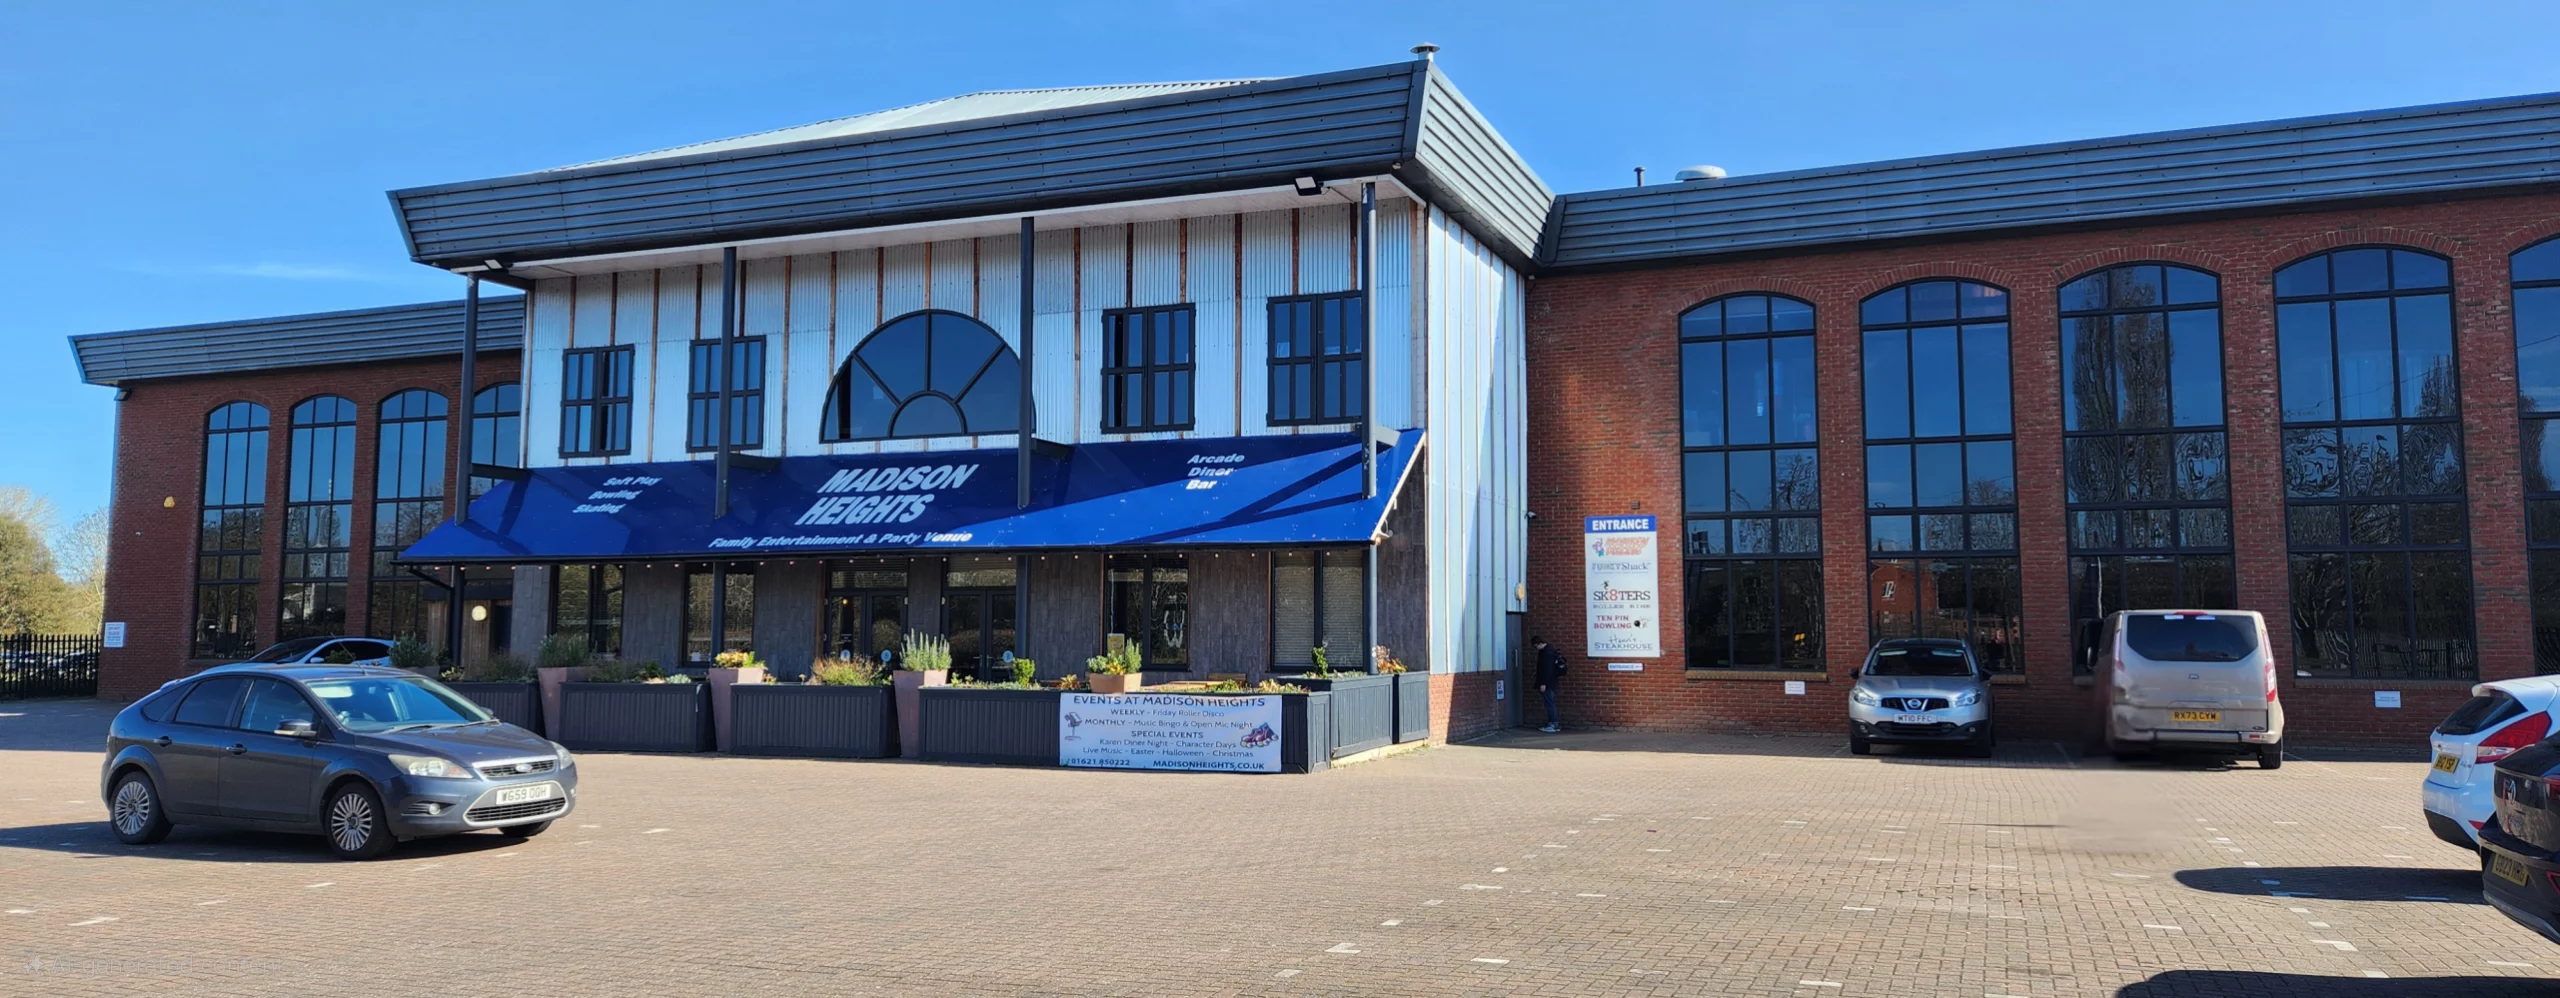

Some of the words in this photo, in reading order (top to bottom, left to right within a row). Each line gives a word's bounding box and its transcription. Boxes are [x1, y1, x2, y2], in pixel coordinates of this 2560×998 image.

[1187, 453, 1245, 464] Arcade
[1188, 466, 1234, 477] Diner
[603, 477, 634, 486] Soft
[631, 476, 663, 486] Play
[817, 464, 979, 493] MADISON
[1186, 480, 1217, 490] Bar
[588, 490, 643, 500] Bowling
[572, 503, 627, 514] Skating
[794, 494, 935, 525] HEIGHTS
[1592, 519, 1649, 530] ENTRANCE
[708, 537, 758, 549] Family
[756, 534, 864, 546] Entertainment
[863, 534, 878, 543] &
[878, 533, 922, 545] Party
[924, 532, 973, 542] Venue
[1593, 589, 1651, 601] SK8TERS
[1074, 695, 1121, 705] EVENTS
[1124, 696, 1140, 705] AT
[1143, 695, 1204, 706] MADISON
[1208, 697, 1265, 707] HEIGHTS
[1153, 709, 1177, 718] Friday
[1179, 709, 1201, 717] Roller
[1085, 718, 1126, 726] MONTHLY
[1159, 720, 1181, 729] Bingo
[1191, 720, 1213, 729] Open
[1215, 721, 1229, 729] Mic
[1231, 721, 1253, 730] Night
[1131, 730, 1166, 738] SPECIAL
[1169, 731, 1203, 739] EVENTS
[1100, 738, 1122, 746] Karen
[1124, 738, 1146, 746] Diner
[1147, 740, 1168, 749] Night
[1176, 741, 1213, 749] Character
[1216, 741, 1237, 750] Days
[1083, 746, 1099, 754] Live
[1101, 747, 1122, 755] Music
[1131, 748, 1154, 756] Easter
[1163, 749, 1204, 757] Halloween
[1213, 750, 1254, 758] Christmas
[1071, 758, 1097, 766] 01621
[1153, 760, 1265, 770] MADISONHEIGHTS.CO.UK
